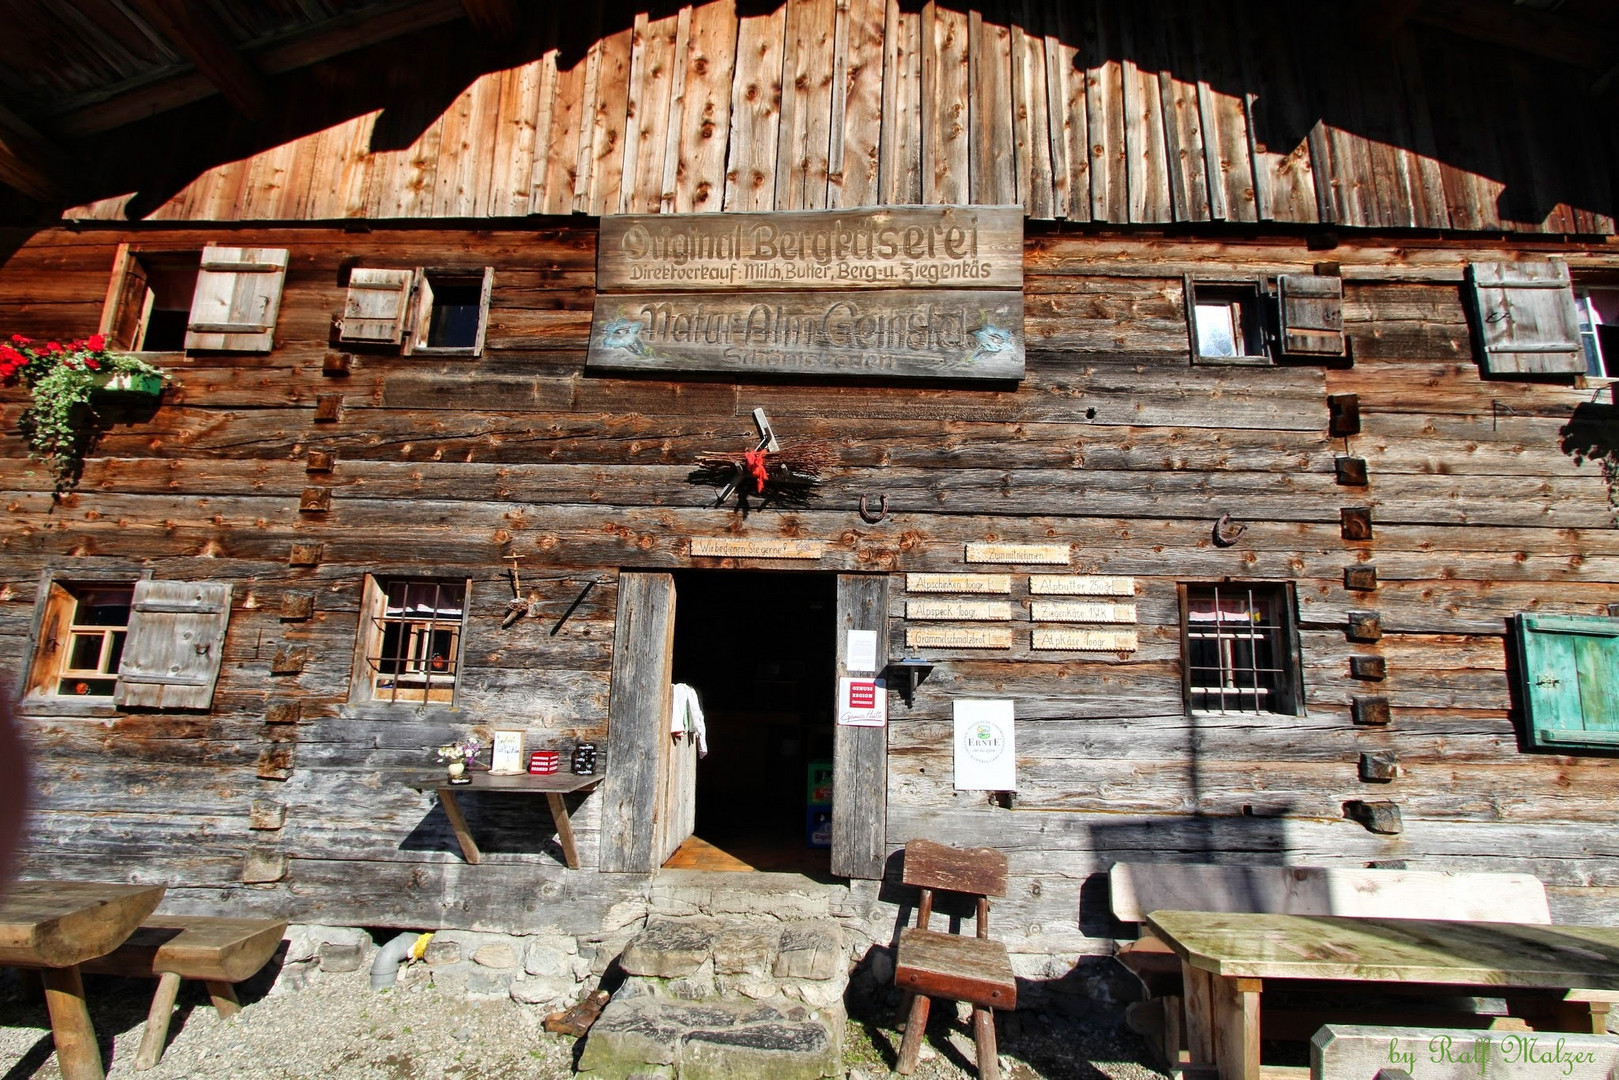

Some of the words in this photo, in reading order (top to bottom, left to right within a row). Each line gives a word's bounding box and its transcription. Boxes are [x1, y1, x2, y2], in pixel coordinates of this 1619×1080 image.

[621, 223, 742, 266] Original
[748, 217, 978, 266] Bergkäserei
[630, 262, 742, 283] Direktverkauf:
[900, 260, 992, 284] Ziegenkäs
[1039, 579, 1085, 593] Alpbutter
